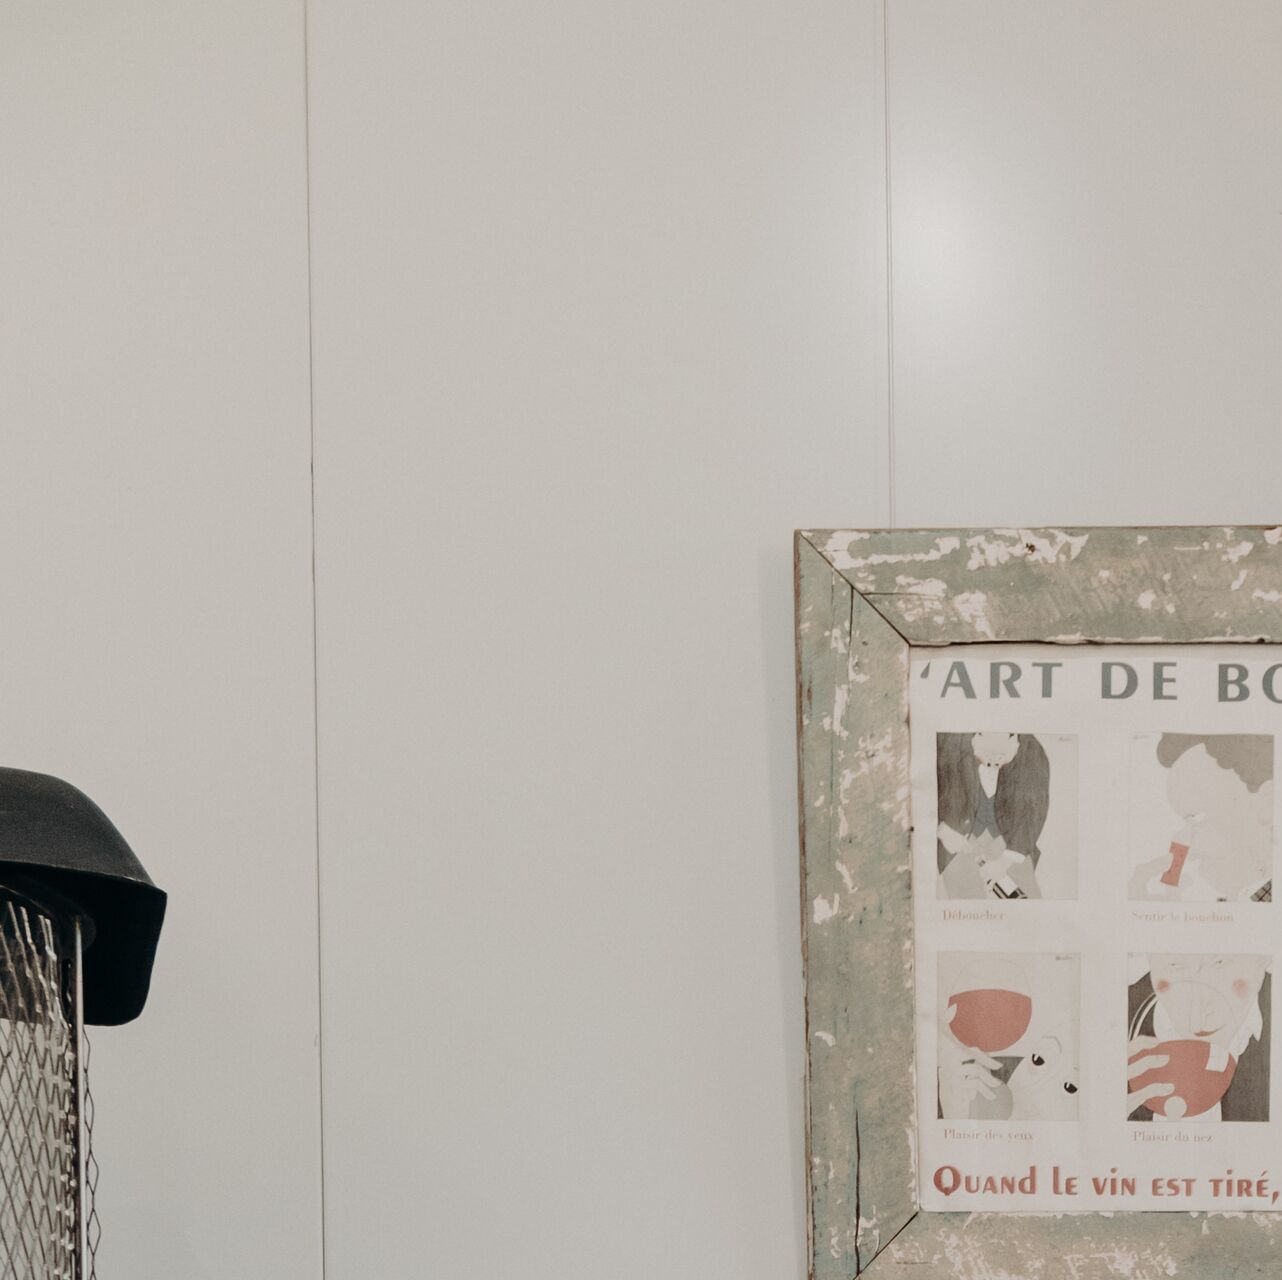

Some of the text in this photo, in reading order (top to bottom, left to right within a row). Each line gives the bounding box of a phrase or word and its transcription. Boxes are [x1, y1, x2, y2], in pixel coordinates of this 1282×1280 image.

[1100, 661, 1179, 701] DE
[933, 1165, 1037, 1197] Quand
[1052, 1165, 1080, 1196] le
[1091, 1167, 1137, 1197] vin
[1151, 1177, 1197, 1198] est
[1208, 1168, 1281, 1205] tiré,
